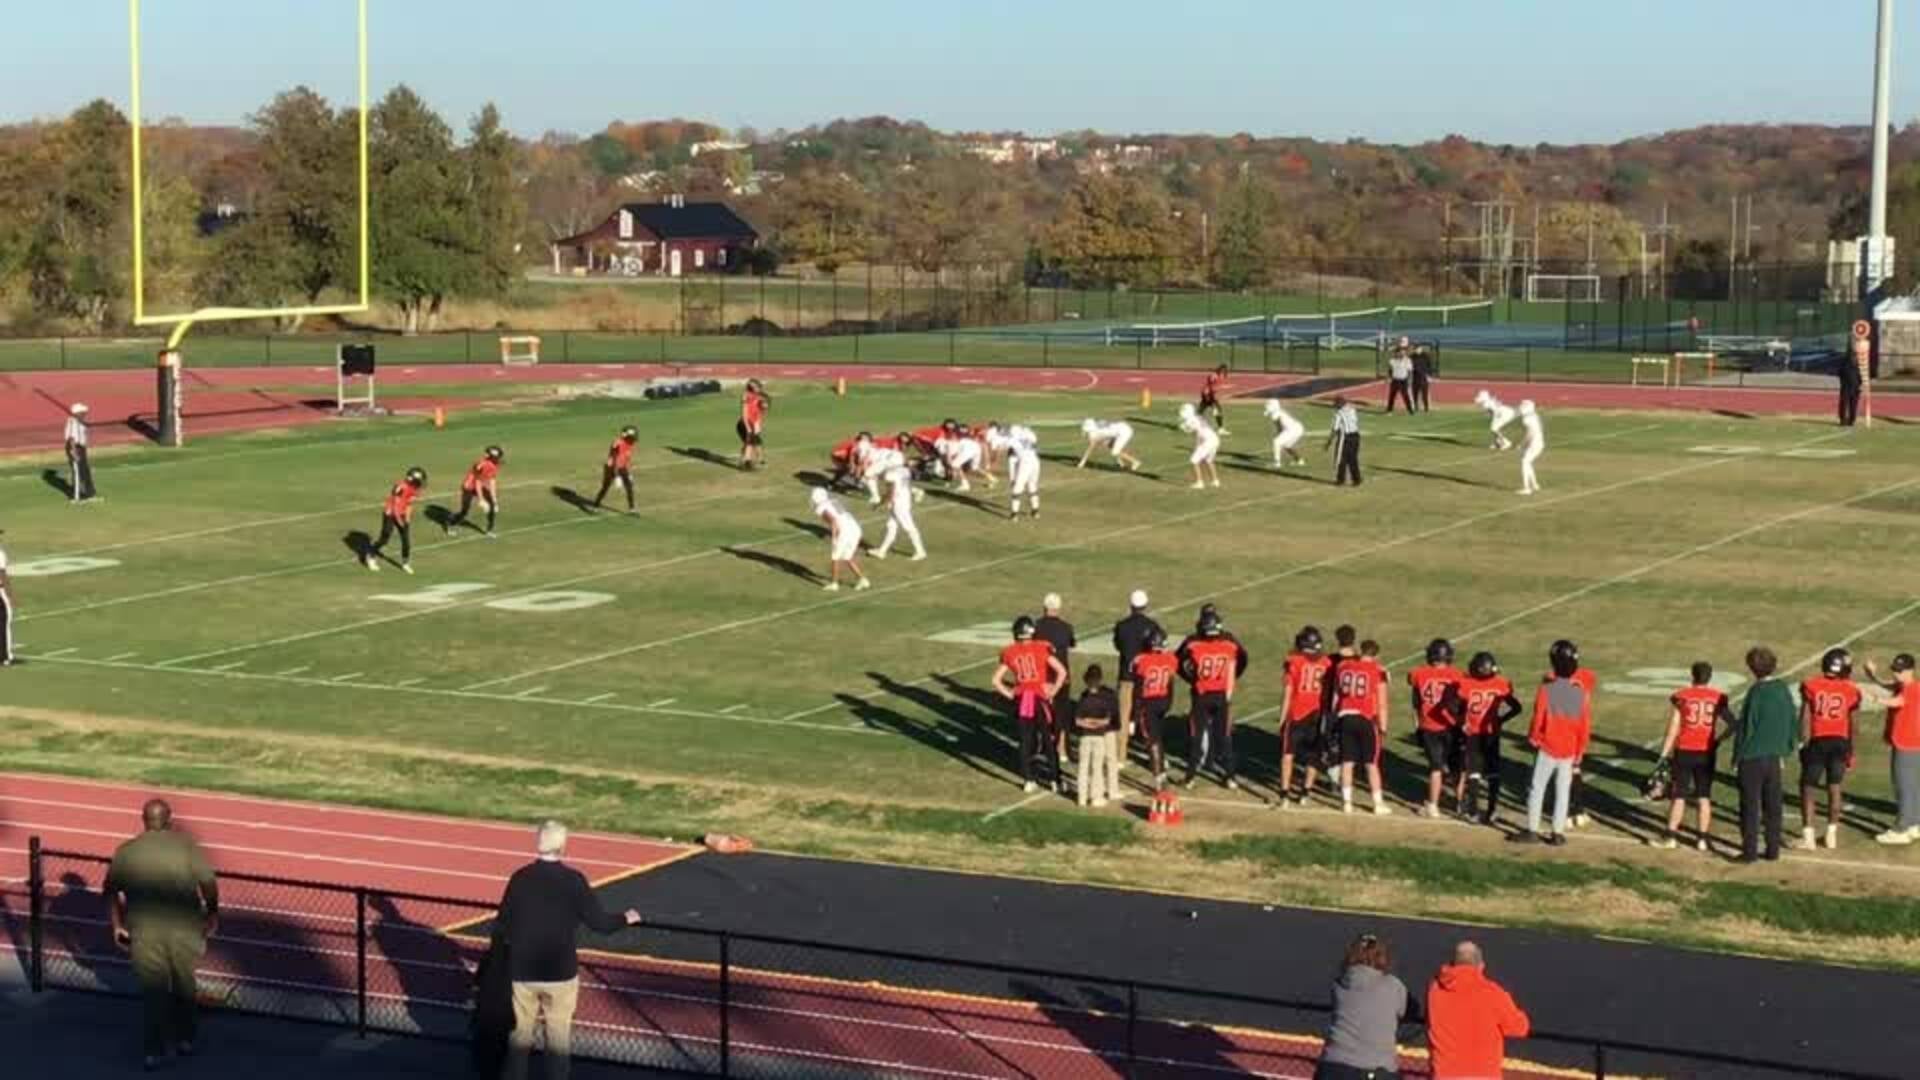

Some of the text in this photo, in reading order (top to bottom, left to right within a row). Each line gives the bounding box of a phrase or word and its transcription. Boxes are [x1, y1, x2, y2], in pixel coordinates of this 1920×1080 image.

[1015, 654, 1038, 682] 11
[1199, 655, 1229, 681] 87
[1814, 690, 1844, 720] 12
